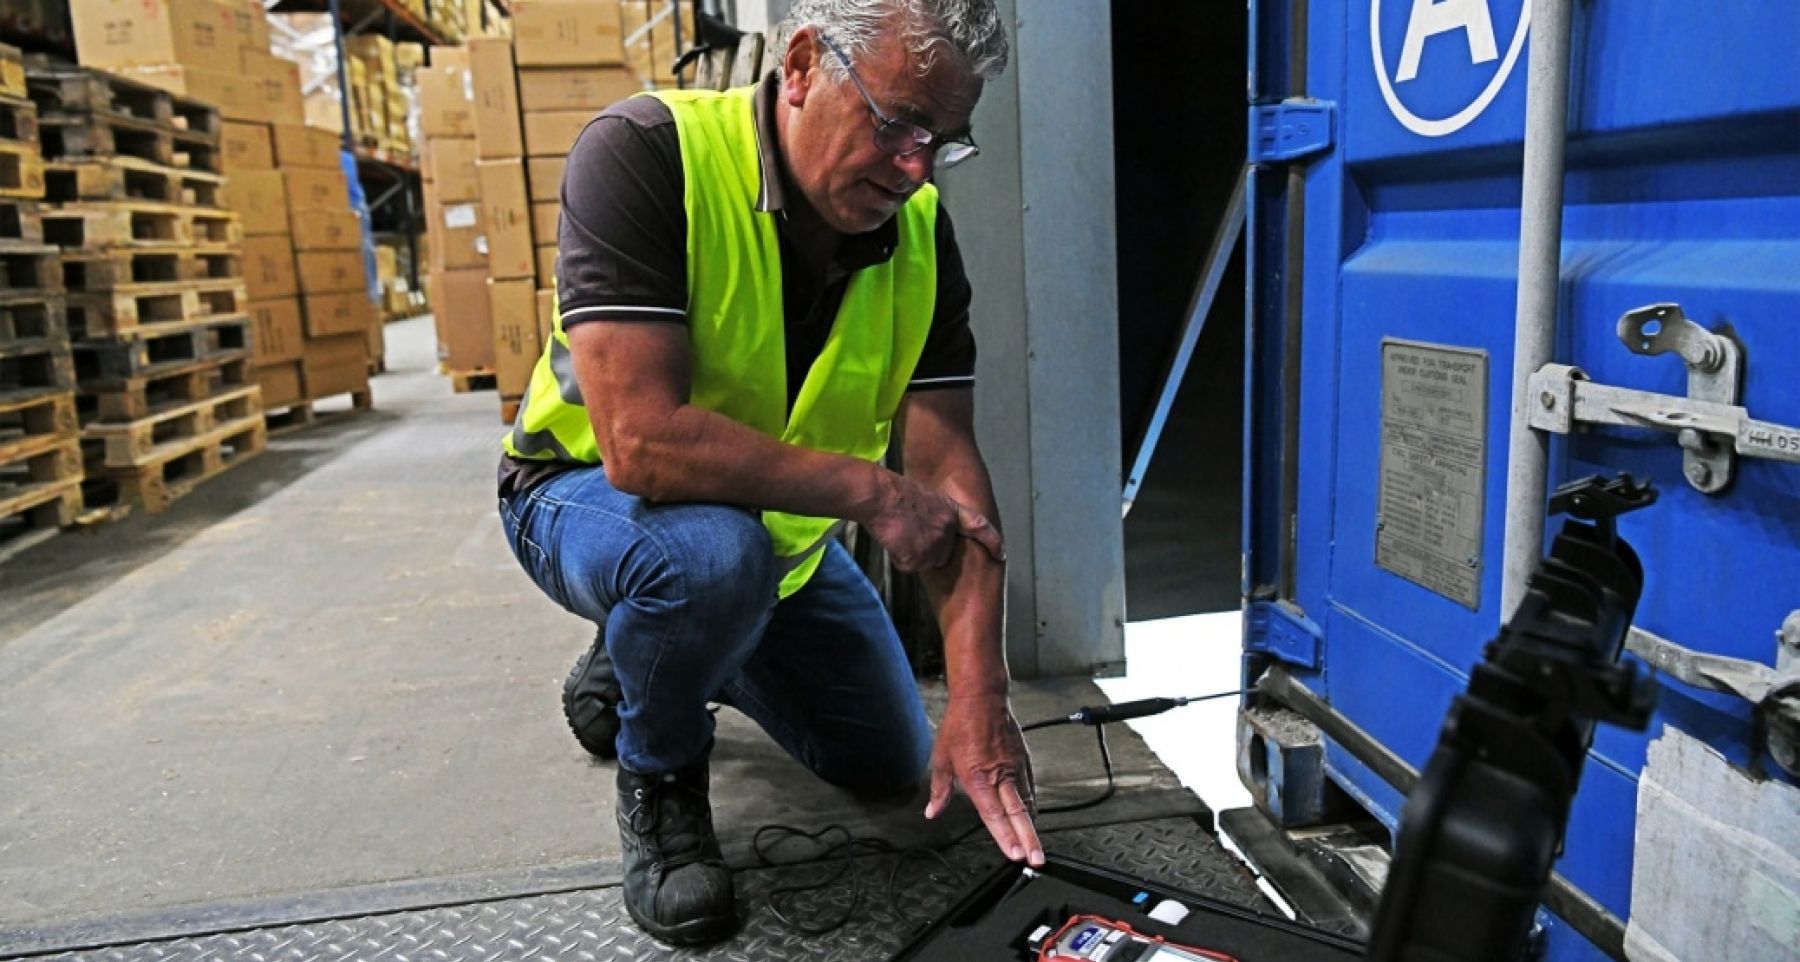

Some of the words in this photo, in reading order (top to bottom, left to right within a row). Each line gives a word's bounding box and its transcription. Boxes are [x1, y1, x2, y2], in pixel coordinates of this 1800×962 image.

[1396, 0, 1498, 83] A
[1438, 360, 1476, 373] TRANSPORT
[1452, 374, 1467, 385] SEAL
